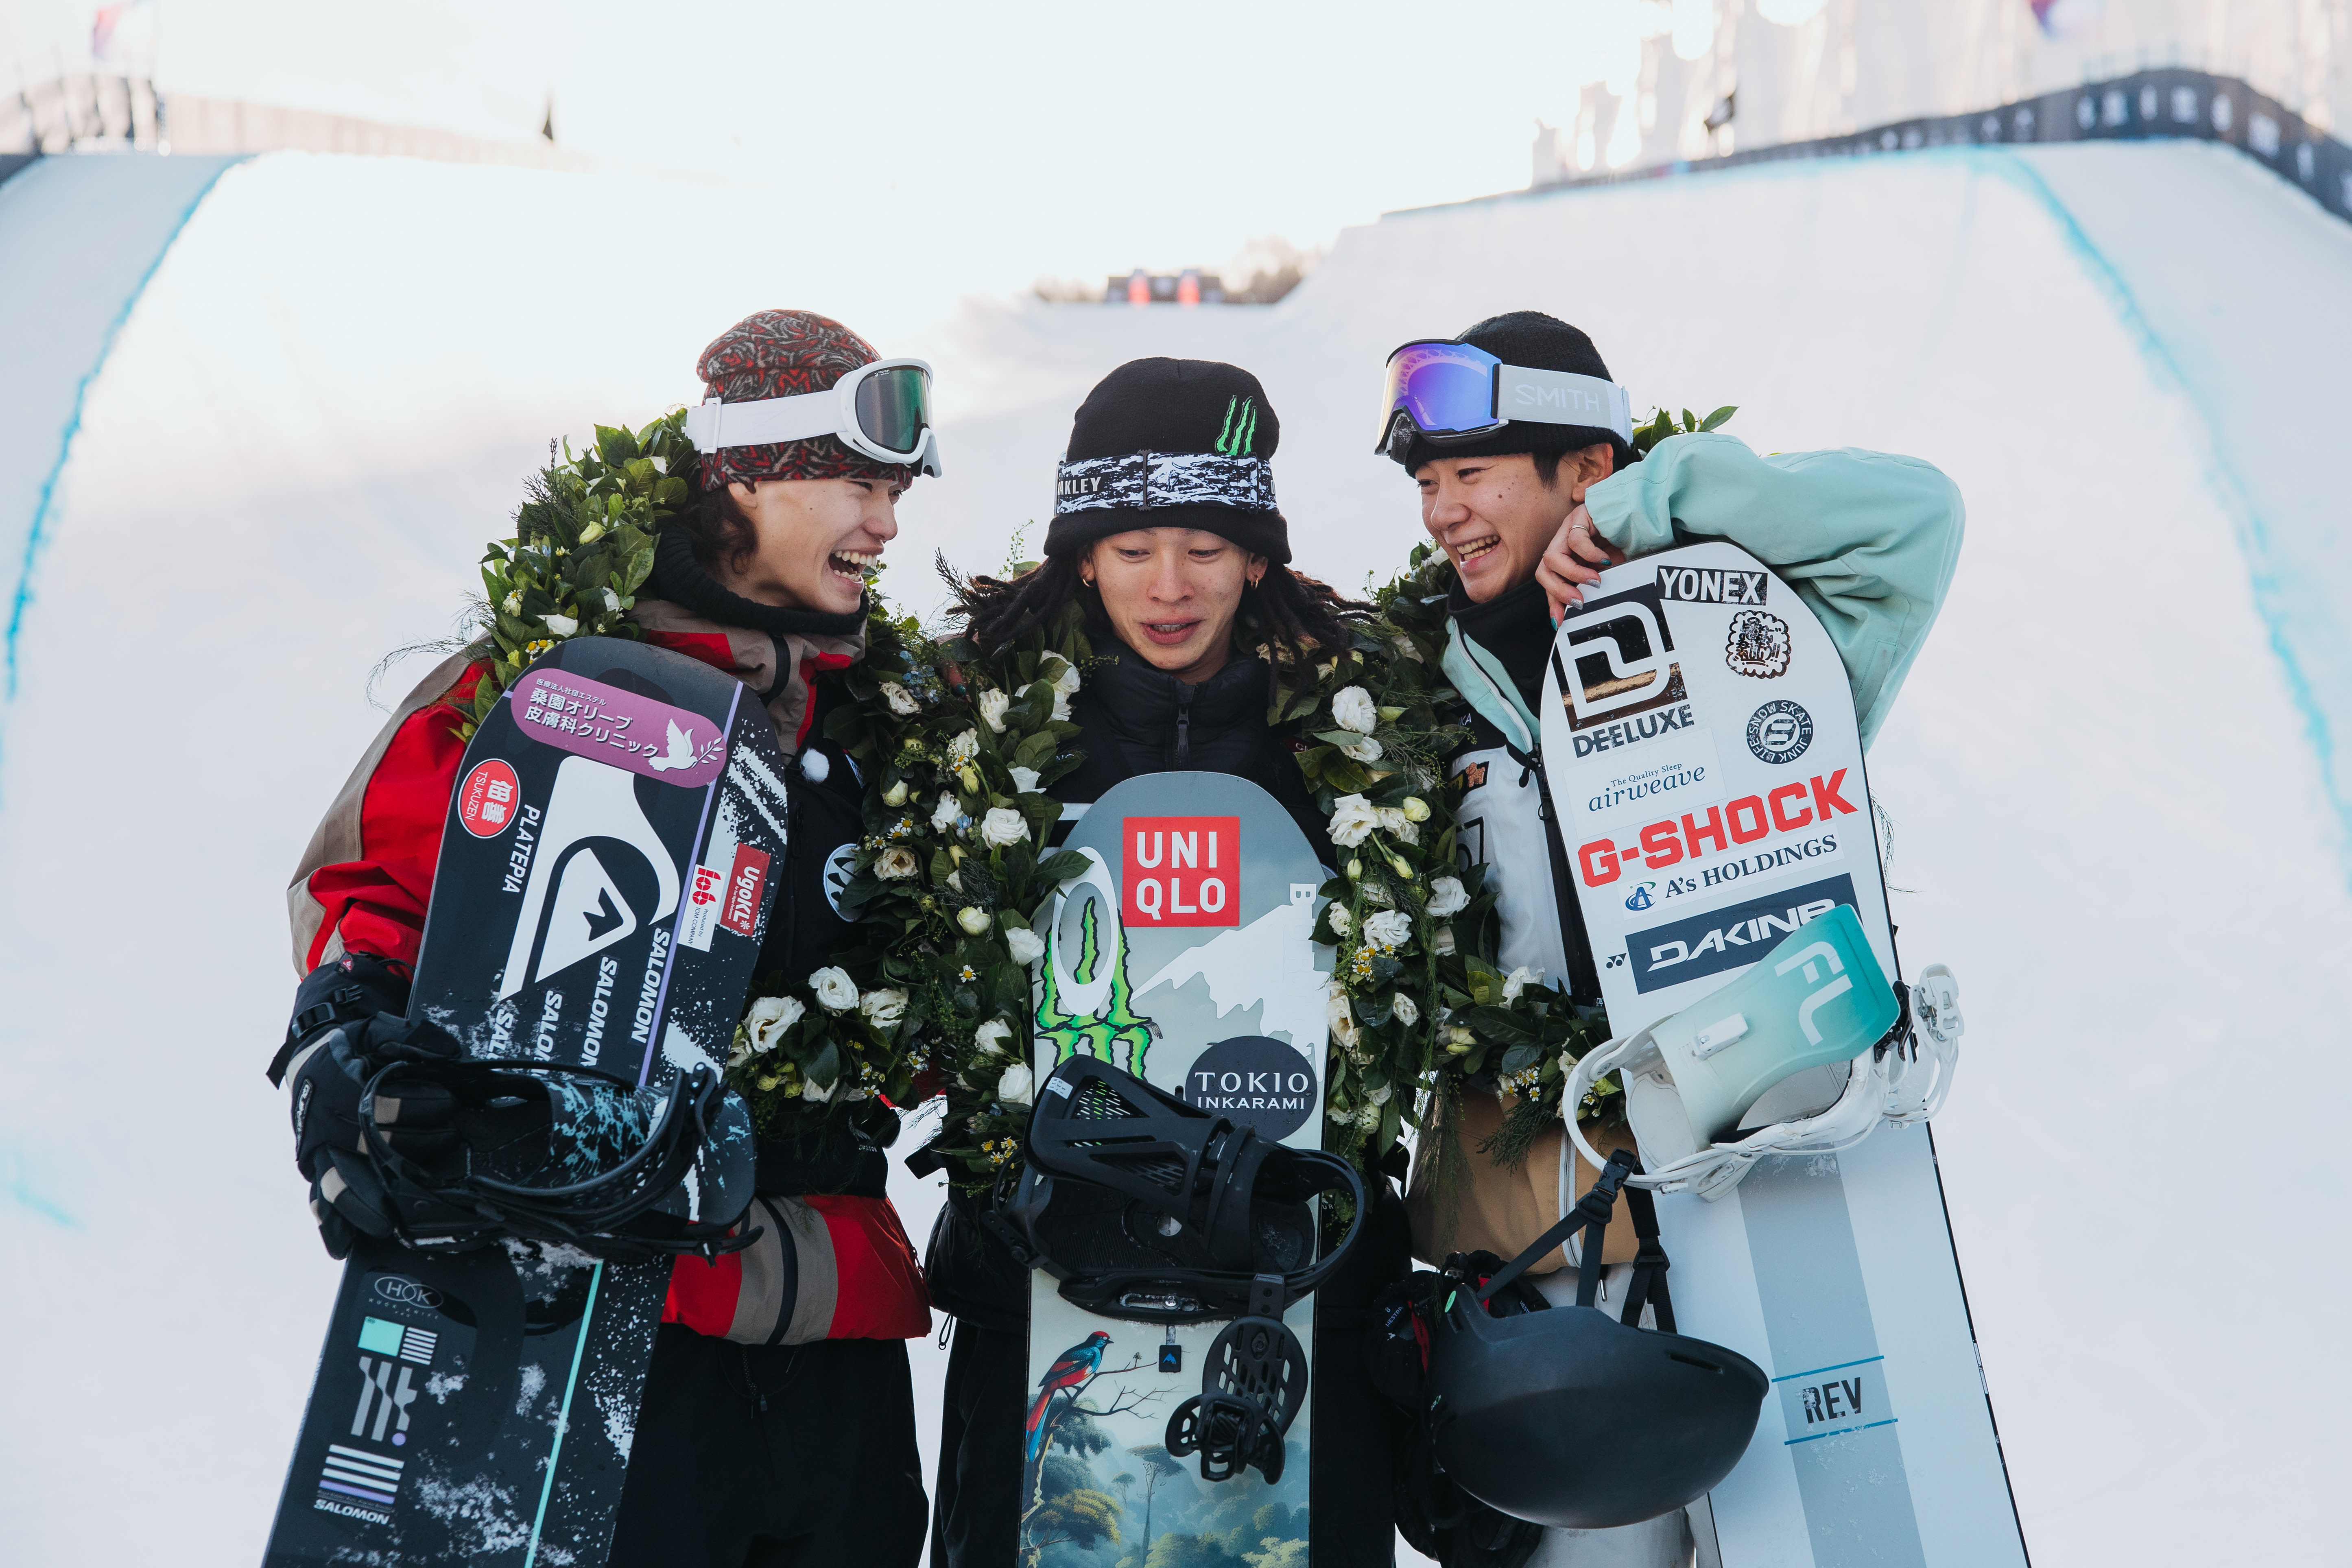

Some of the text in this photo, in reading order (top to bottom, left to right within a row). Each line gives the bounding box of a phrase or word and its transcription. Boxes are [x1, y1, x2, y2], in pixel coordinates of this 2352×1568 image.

[1515, 384, 1600, 413] SMITH
[1058, 476, 1101, 496] AKLEY
[1659, 568, 1761, 605] YONEX
[530, 687, 633, 729] 桑園オリーブ
[536, 678, 607, 706] 医療法人社団エステル
[524, 706, 658, 757] 皮膚科クリニック
[1572, 704, 1695, 759] DEELUXE
[1749, 702, 1812, 763] SNOW SKATE JUNK LIFE
[465, 771, 488, 821] TSUKUZEN
[1588, 766, 1706, 812] airweave
[1611, 763, 1682, 787] The Quality Sleep
[502, 804, 541, 893] PLATEPIA
[1577, 767, 1858, 888] G-SHOCK
[1136, 831, 1217, 869] UNI
[1665, 877, 1697, 899] A's
[1701, 834, 1837, 887] HOLDINGS
[700, 908, 709, 931] Produced
[1136, 877, 1226, 921] QLO
[688, 919, 698, 945] COMPANY
[1647, 898, 1836, 972] DAKINE
[631, 928, 670, 1044] SALOMON
[1195, 1072, 1309, 1093] TOKIO
[1197, 1096, 1305, 1110] INKARAMI
[1385, 1307, 1404, 1327] HESTRA
[1802, 1377, 1862, 1424] REV
[314, 1498, 390, 1525] SALOMON
